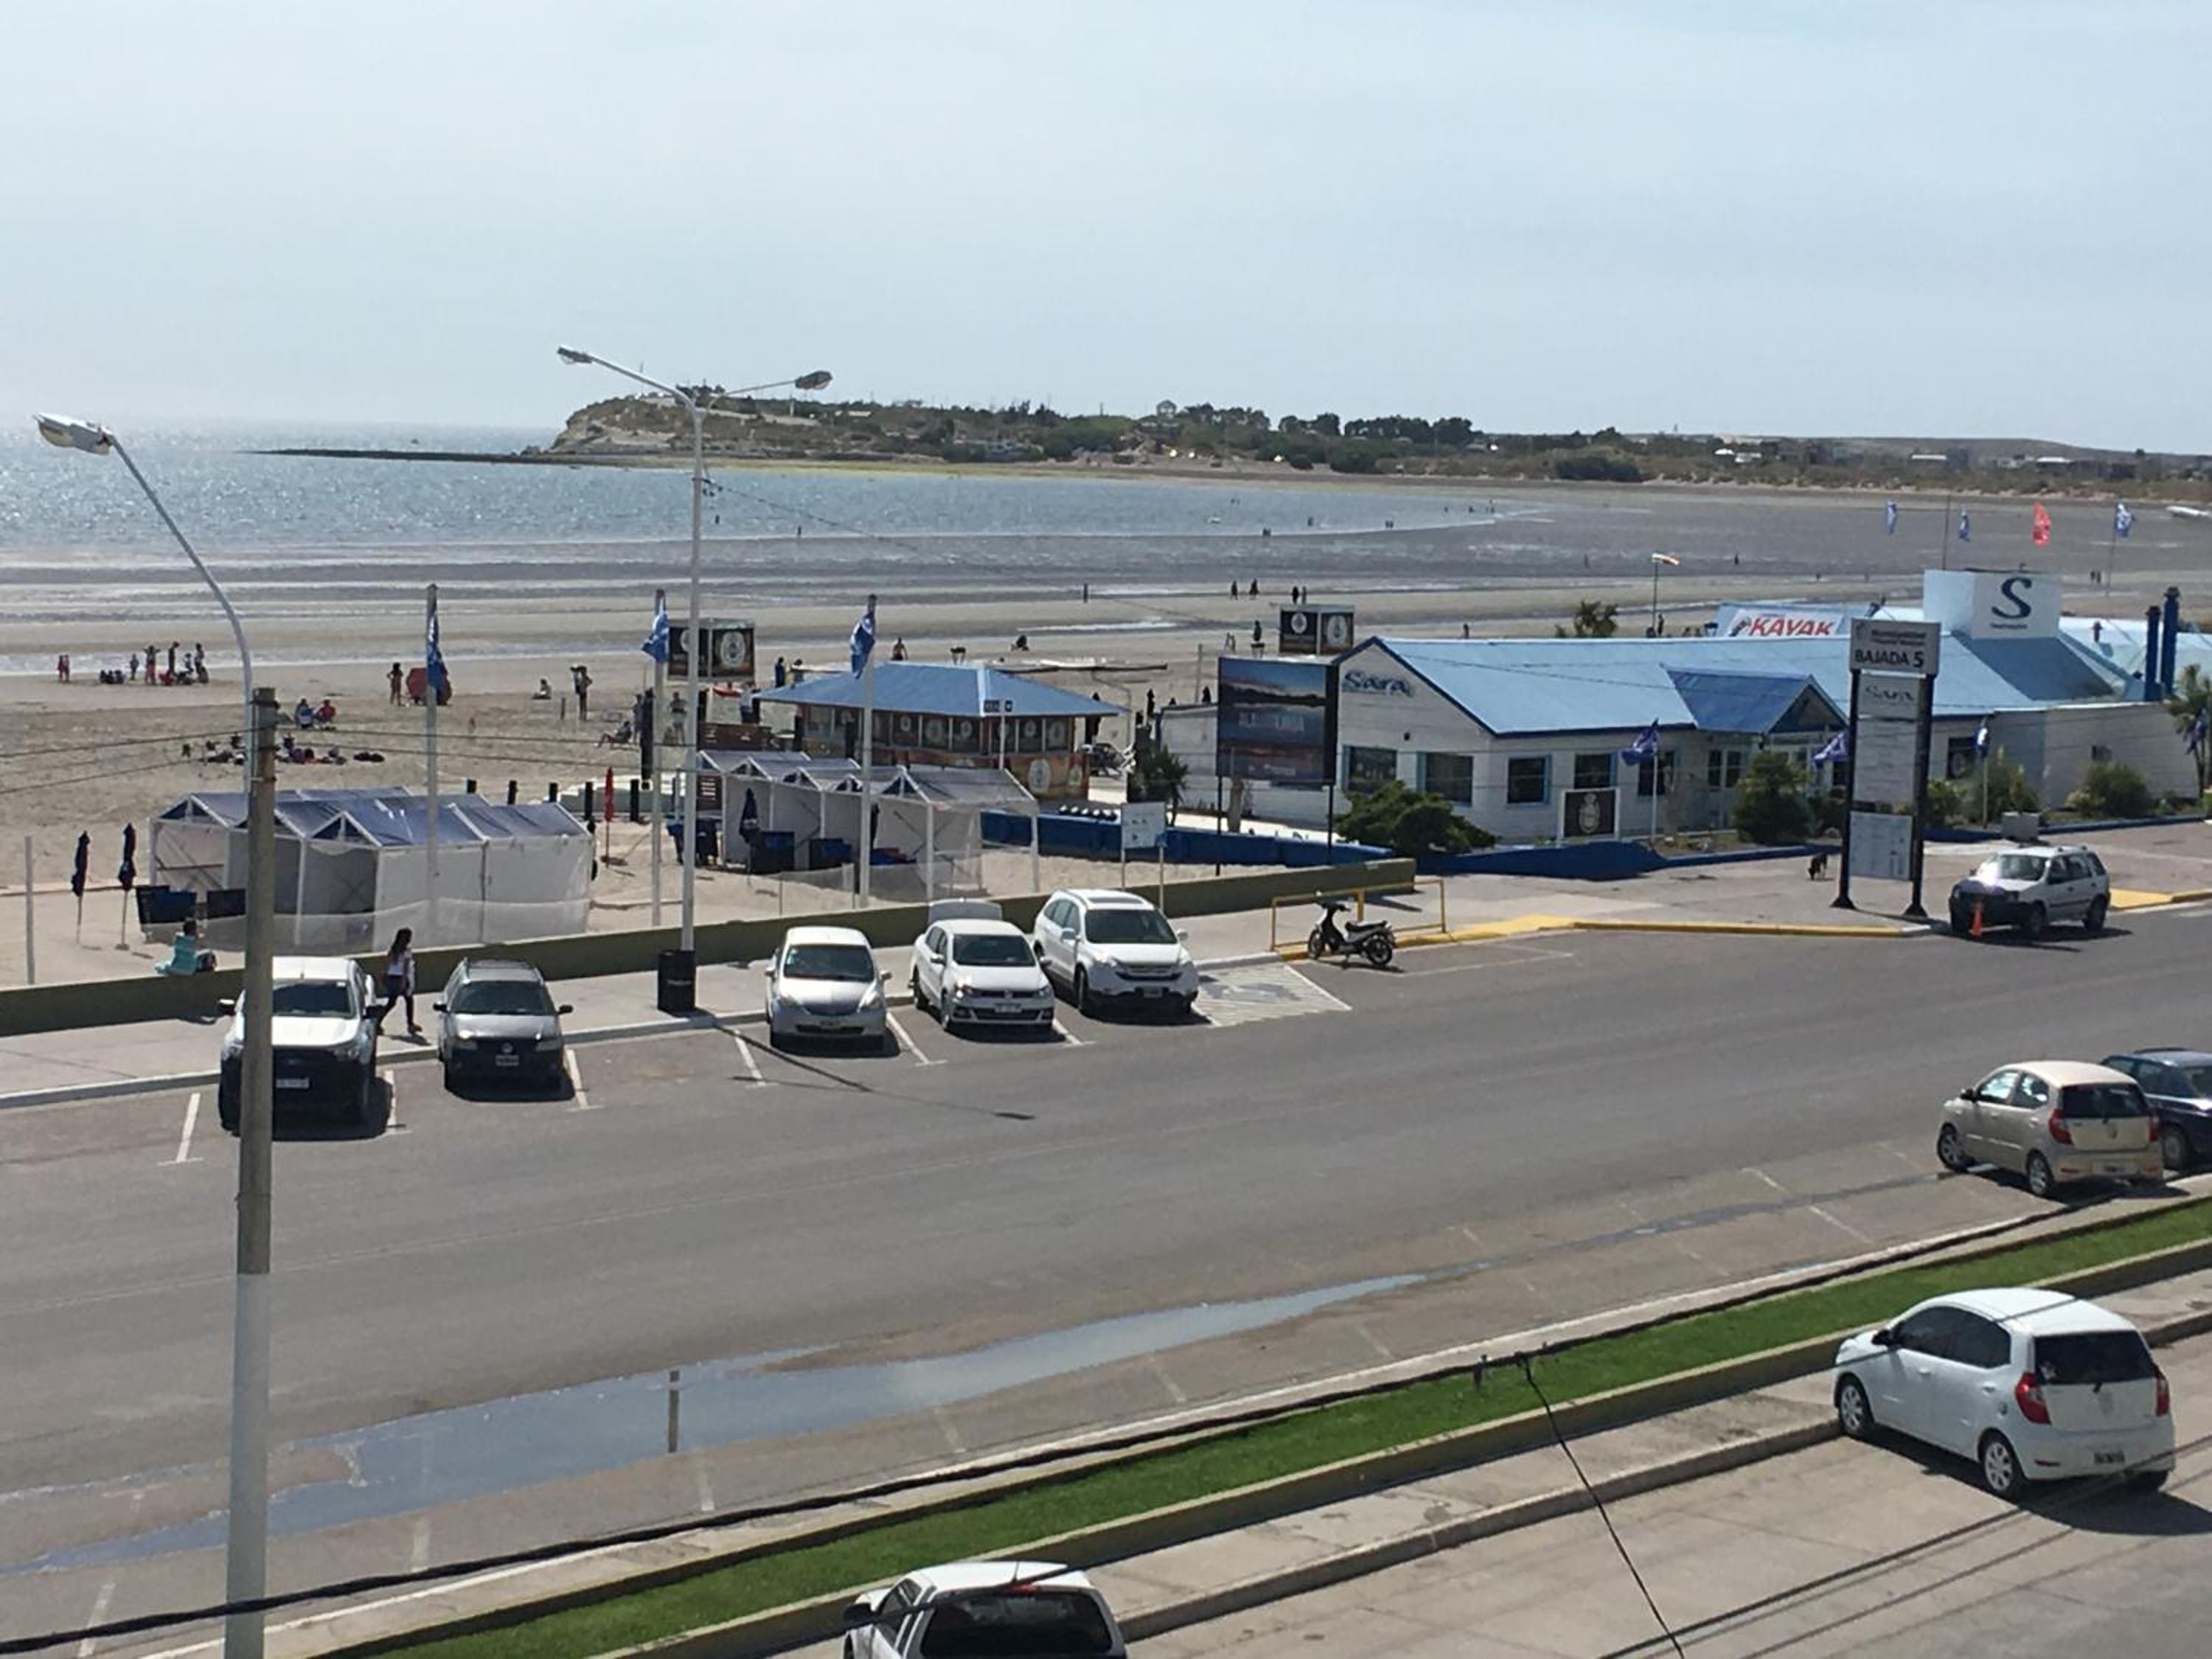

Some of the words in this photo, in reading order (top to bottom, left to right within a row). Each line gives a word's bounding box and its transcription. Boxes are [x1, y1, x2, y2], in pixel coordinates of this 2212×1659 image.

[1992, 577, 2031, 619] S
[1749, 617, 1834, 637] KAYAK
[1854, 650, 1910, 665] BAJADA
[1913, 650, 1924, 667] 5
